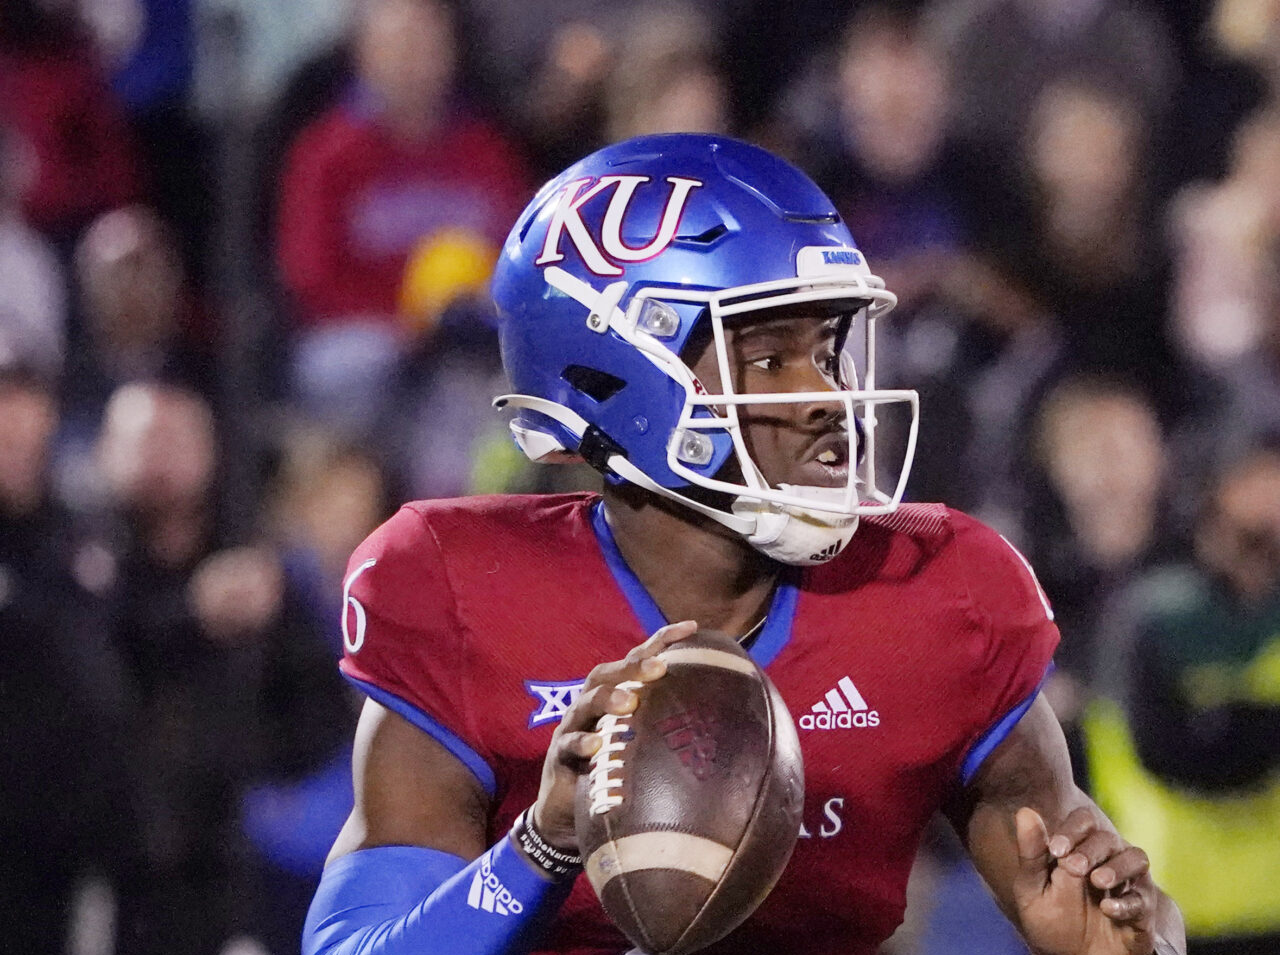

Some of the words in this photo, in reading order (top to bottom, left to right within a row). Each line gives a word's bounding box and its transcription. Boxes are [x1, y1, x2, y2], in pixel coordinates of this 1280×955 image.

[535, 175, 703, 275] KU
[342, 558, 377, 653] 6
[799, 709, 880, 730] adidas
